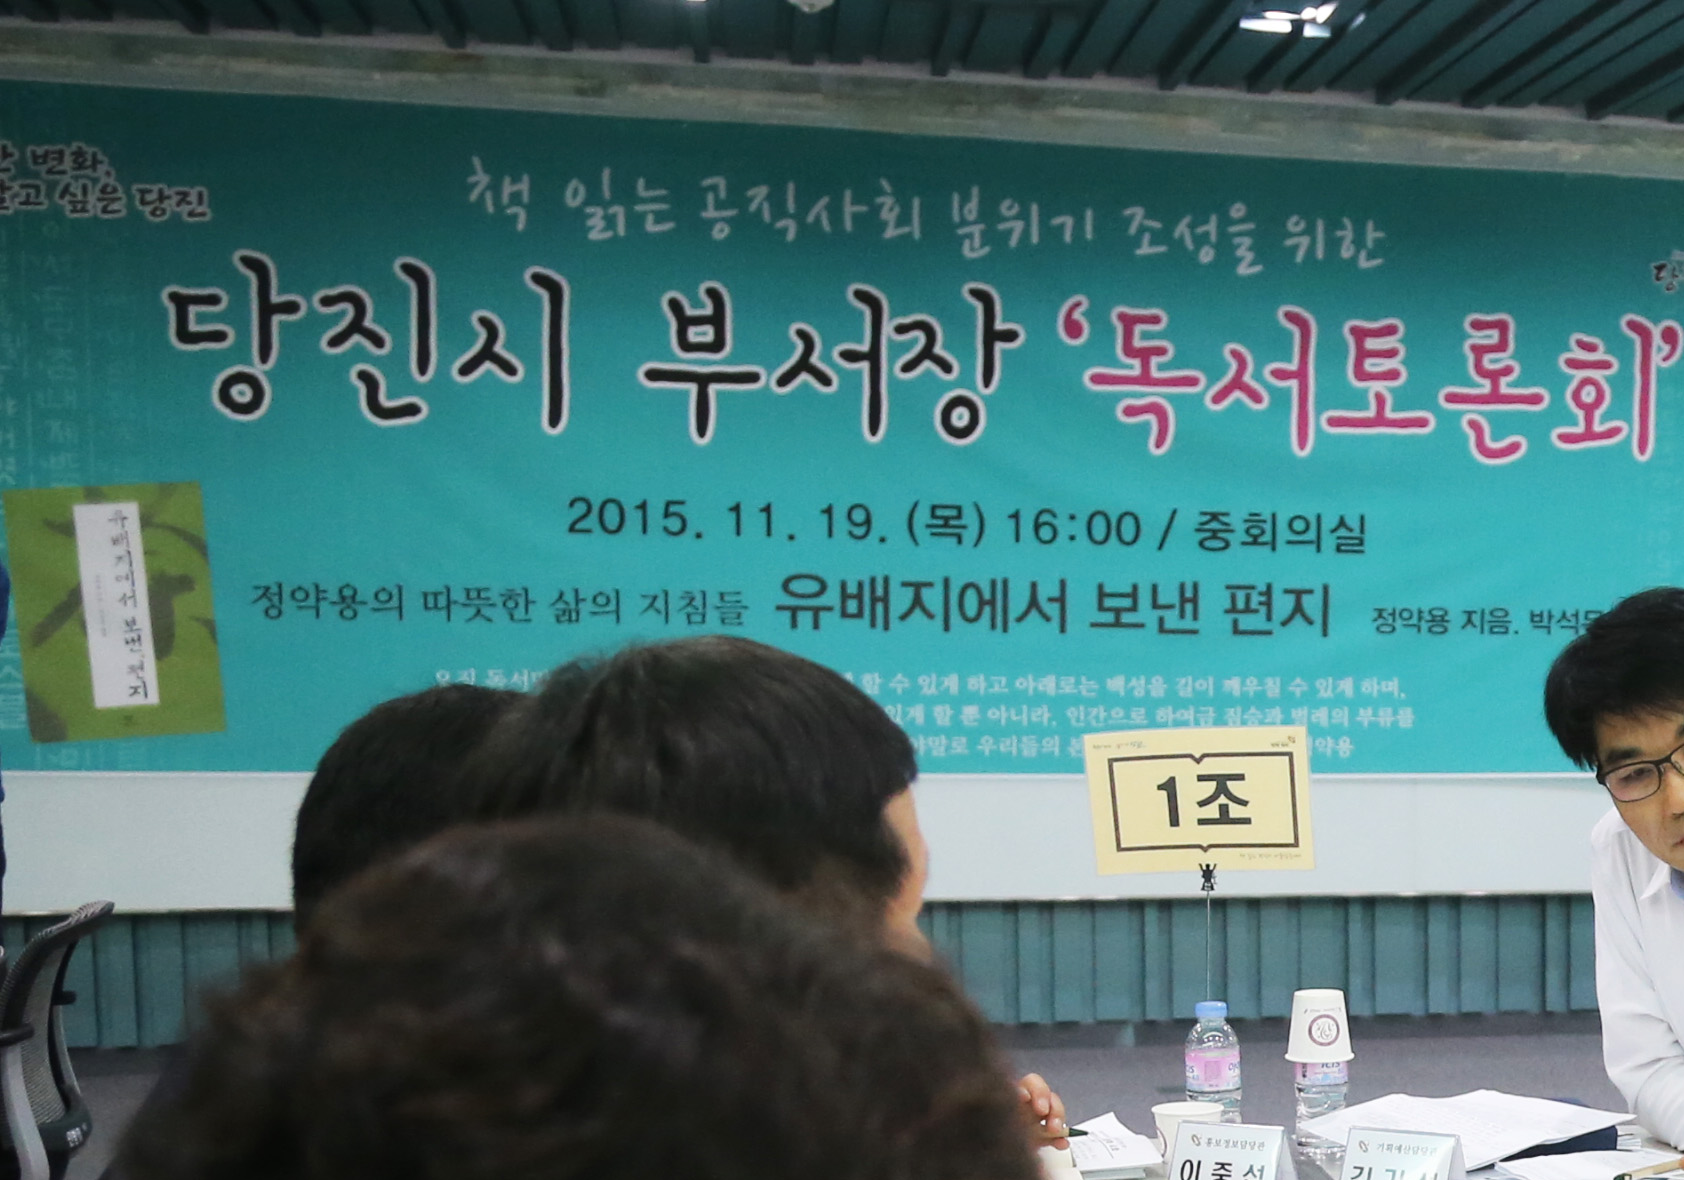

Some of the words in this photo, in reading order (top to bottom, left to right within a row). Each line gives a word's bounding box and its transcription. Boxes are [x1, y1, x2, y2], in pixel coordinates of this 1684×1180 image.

[57, 179, 127, 217] 싶은
[132, 183, 212, 221] 당진
[467, 156, 530, 231] 책
[565, 167, 676, 240] 읽는
[701, 176, 920, 241] 공직사회
[953, 185, 1094, 258] 분위기
[1122, 202, 1262, 275] 조성을
[1284, 214, 1386, 268] 위한
[161, 248, 571, 435] 당진시
[637, 279, 1025, 446] 부서장
[567, 496, 702, 539] 2015.
[728, 502, 795, 541] 11.
[1007, 507, 1142, 547] 16:00
[1157, 507, 1178, 551] /
[1195, 511, 1367, 555] 중회의실
[251, 582, 405, 622] 정약용의
[422, 585, 537, 624] 따뜻한
[549, 588, 622, 625] 삶의
[639, 589, 750, 627] 지침들
[773, 572, 1069, 634] 유배지에서
[1089, 580, 1201, 636] 보낸
[1223, 582, 1331, 638] 편지
[1371, 606, 1450, 636] 정약용
[888, 673, 912, 696] 수
[917, 672, 960, 697] 있게
[966, 673, 1010, 696] 하고
[1015, 674, 1099, 698] 아래로는
[1287, 676, 1309, 699] 수
[1314, 676, 1355, 699] 있게
[933, 704, 955, 727] 할
[1065, 705, 1150, 728] 인간으로
[978, 735, 1061, 758] 우리들의
[1157, 773, 1252, 828] 1조
